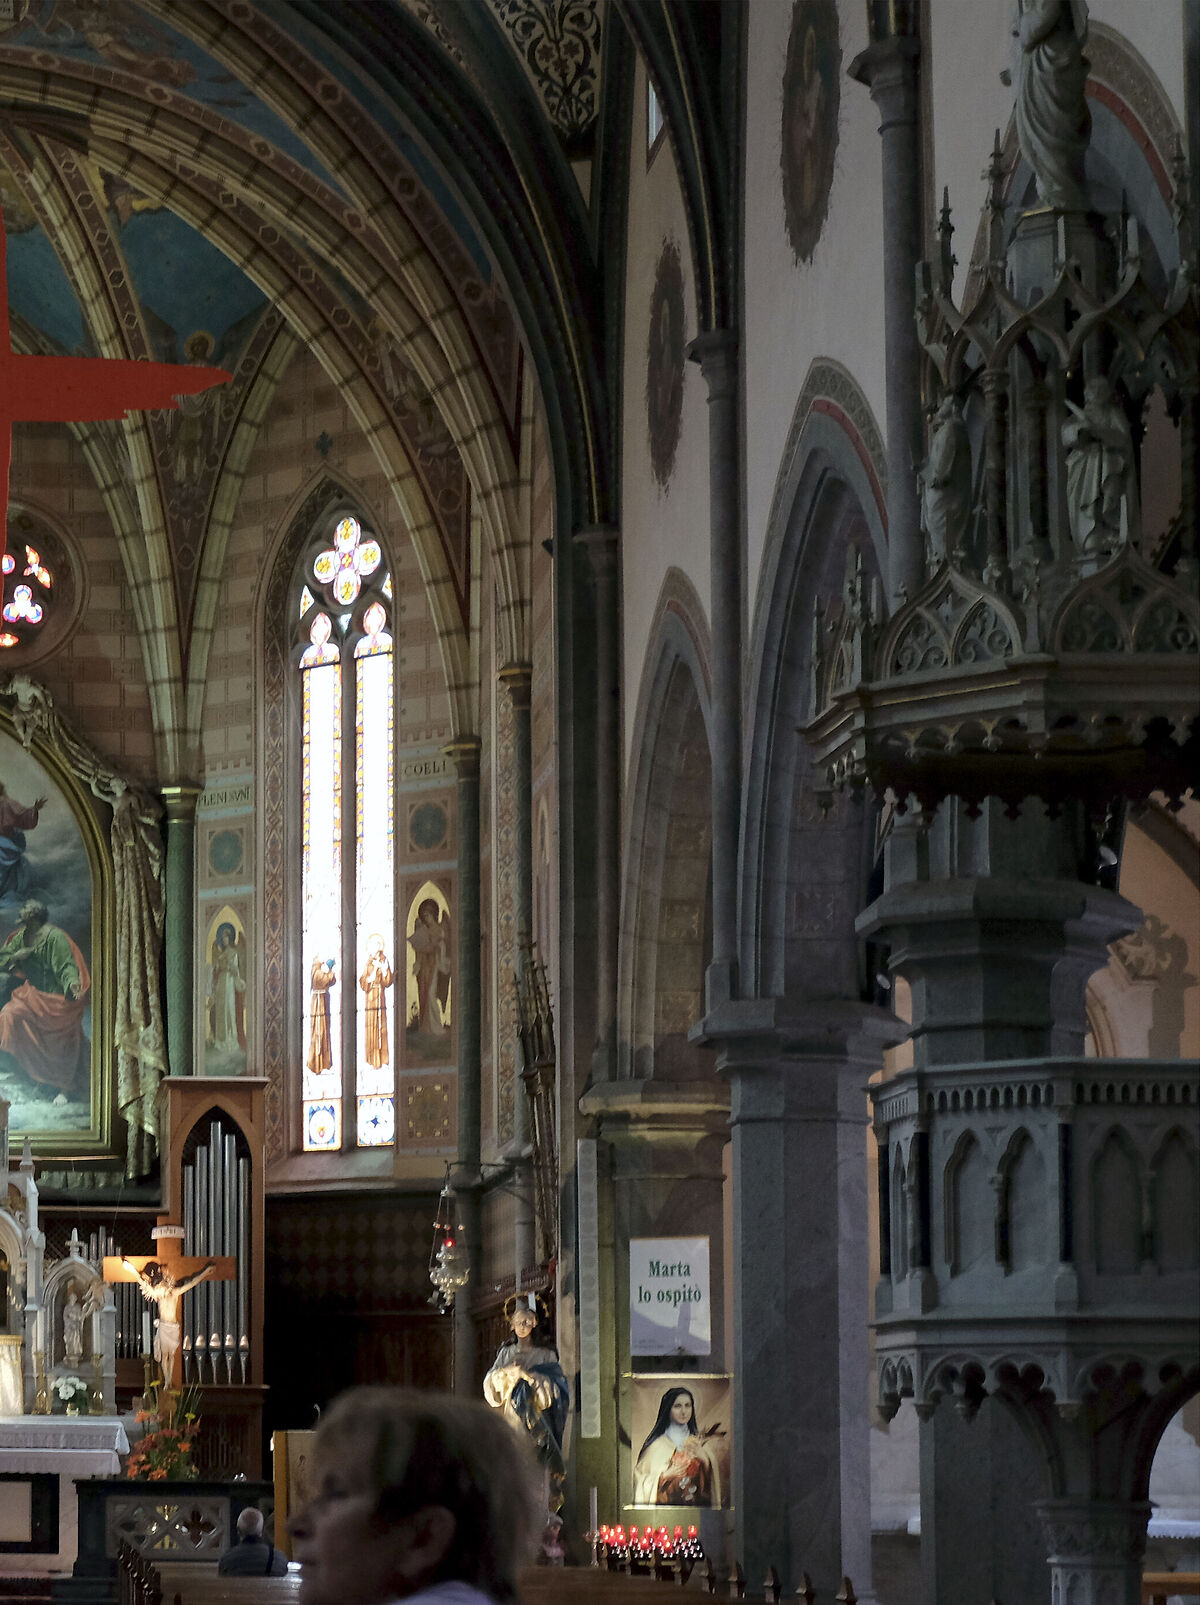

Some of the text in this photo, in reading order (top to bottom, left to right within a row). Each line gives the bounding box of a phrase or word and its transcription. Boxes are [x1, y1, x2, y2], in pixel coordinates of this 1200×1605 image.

[648, 1260, 691, 1278] Marta
[638, 1283, 702, 1308] lo ospitò
